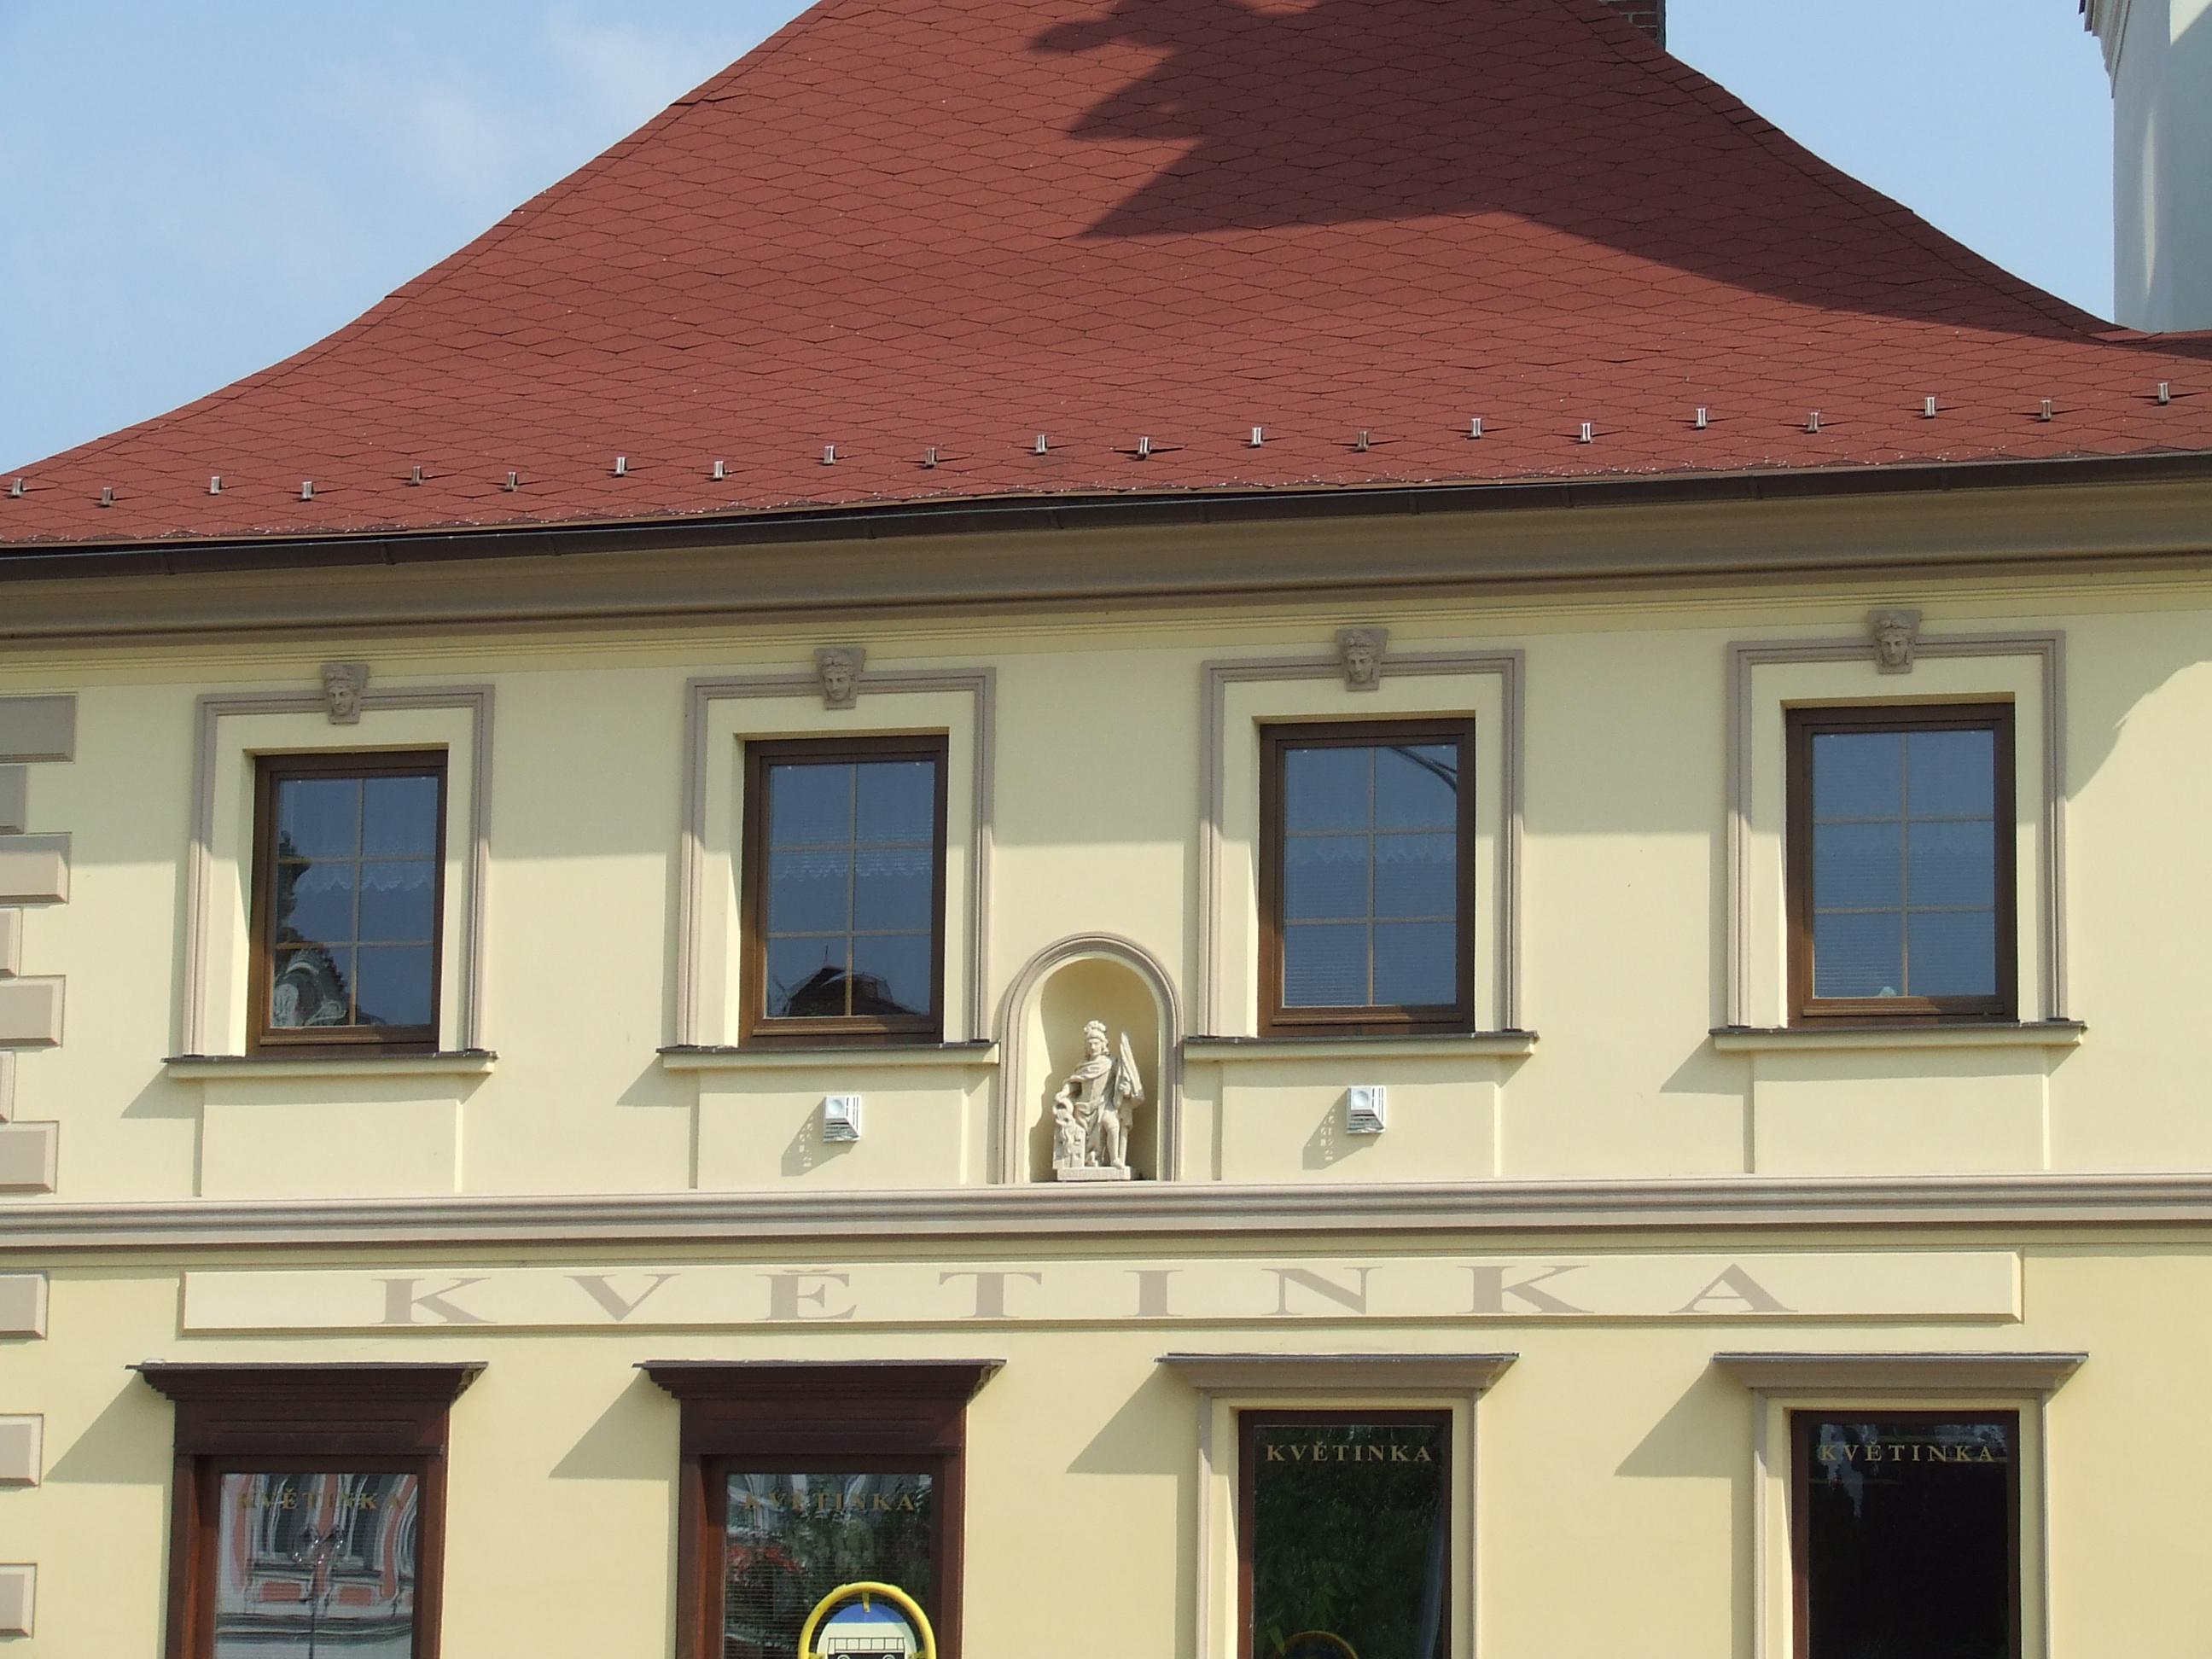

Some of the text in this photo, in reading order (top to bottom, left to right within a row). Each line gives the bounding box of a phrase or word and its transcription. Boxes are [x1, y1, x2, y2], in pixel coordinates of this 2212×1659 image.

[369, 1263, 1799, 1324] KVĚTINKA
[1265, 1441, 1433, 1462] KVĚTINKA
[1819, 1440, 1995, 1463] KVĚTINKA
